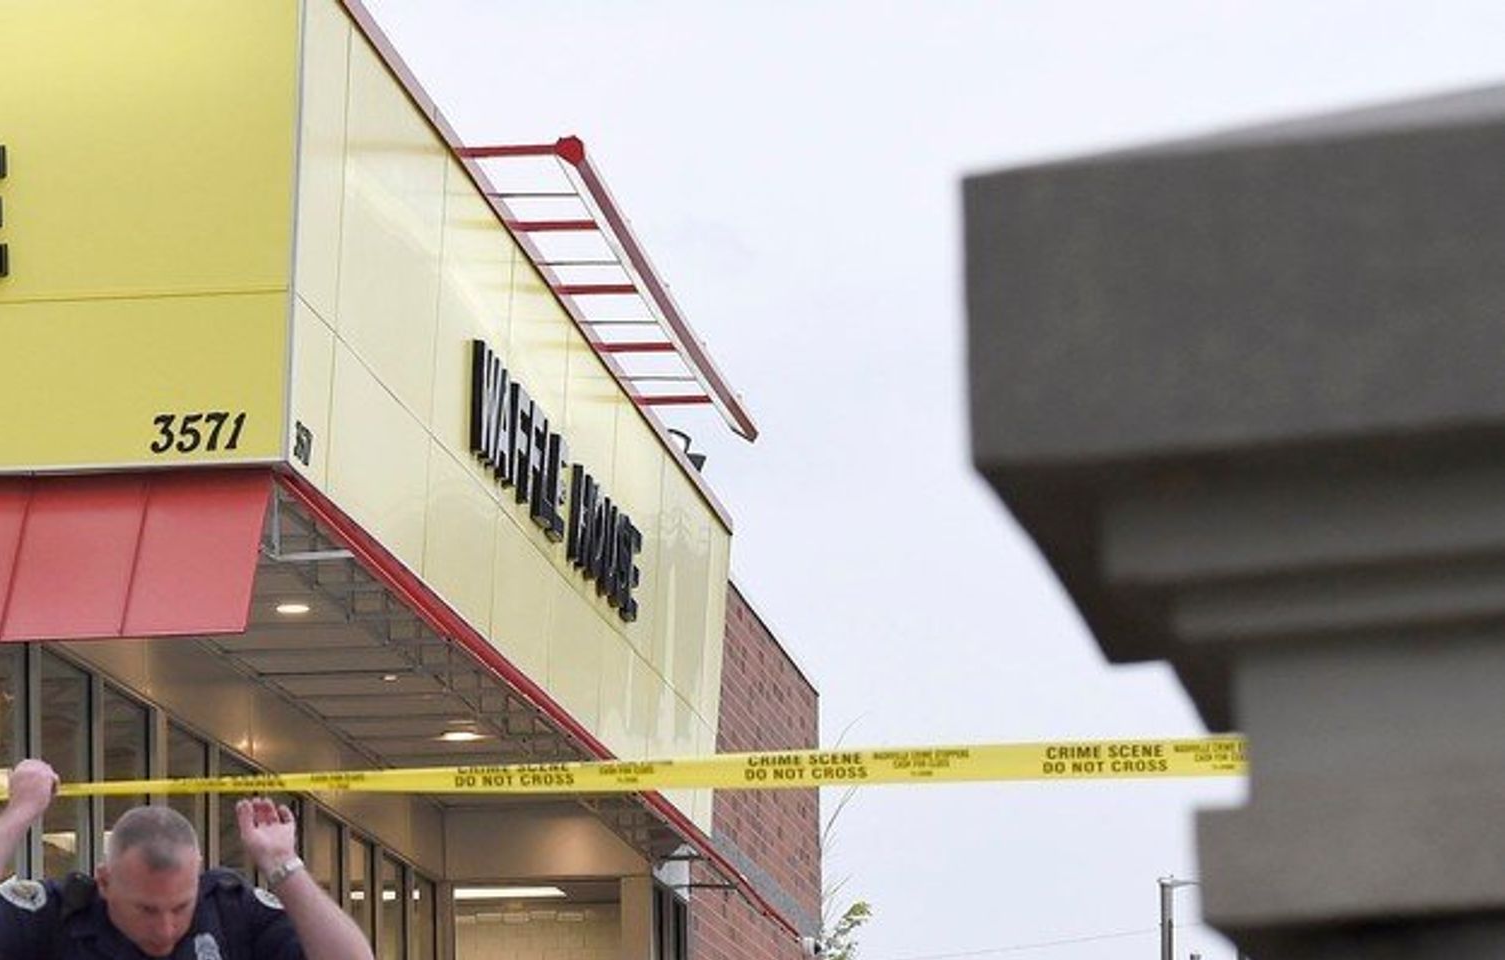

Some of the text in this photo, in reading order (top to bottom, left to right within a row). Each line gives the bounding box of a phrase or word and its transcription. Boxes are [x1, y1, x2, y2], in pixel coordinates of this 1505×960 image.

[150, 411, 246, 454] 3571
[470, 339, 570, 543] WAFFLE
[748, 754, 801, 767] CRIME
[808, 751, 863, 765] SCENE
[1046, 745, 1102, 760] CRIME
[1107, 743, 1164, 758] SCENE
[744, 766, 868, 781] DO NOT CROSS
[1043, 758, 1169, 774] DO NOT CROSS
[454, 773, 575, 788] DO NOT CROSS
